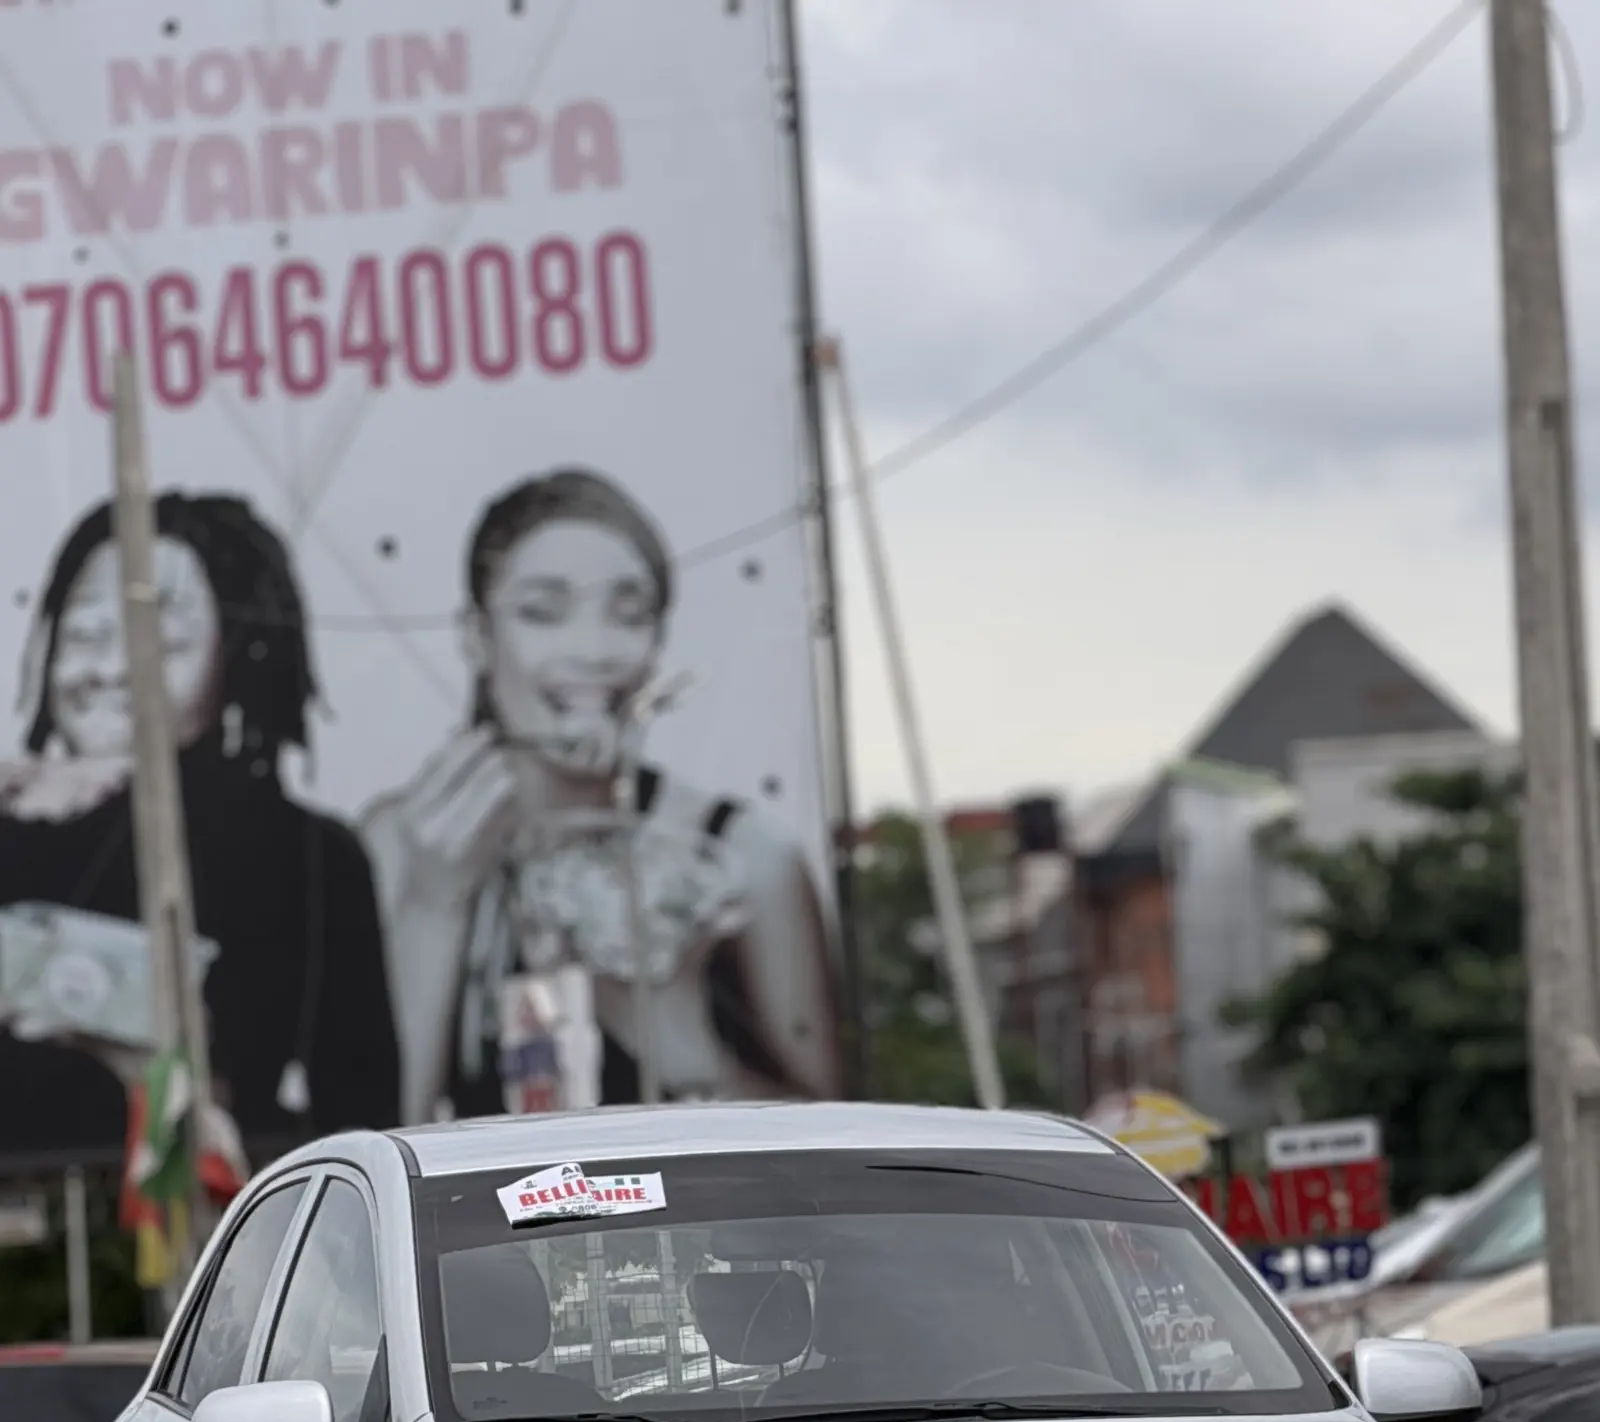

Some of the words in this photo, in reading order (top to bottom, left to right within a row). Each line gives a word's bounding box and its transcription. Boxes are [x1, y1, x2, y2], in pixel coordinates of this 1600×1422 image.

[107, 39, 341, 126] NOW
[368, 30, 471, 103] IN
[0, 100, 623, 243] GWARINPA
